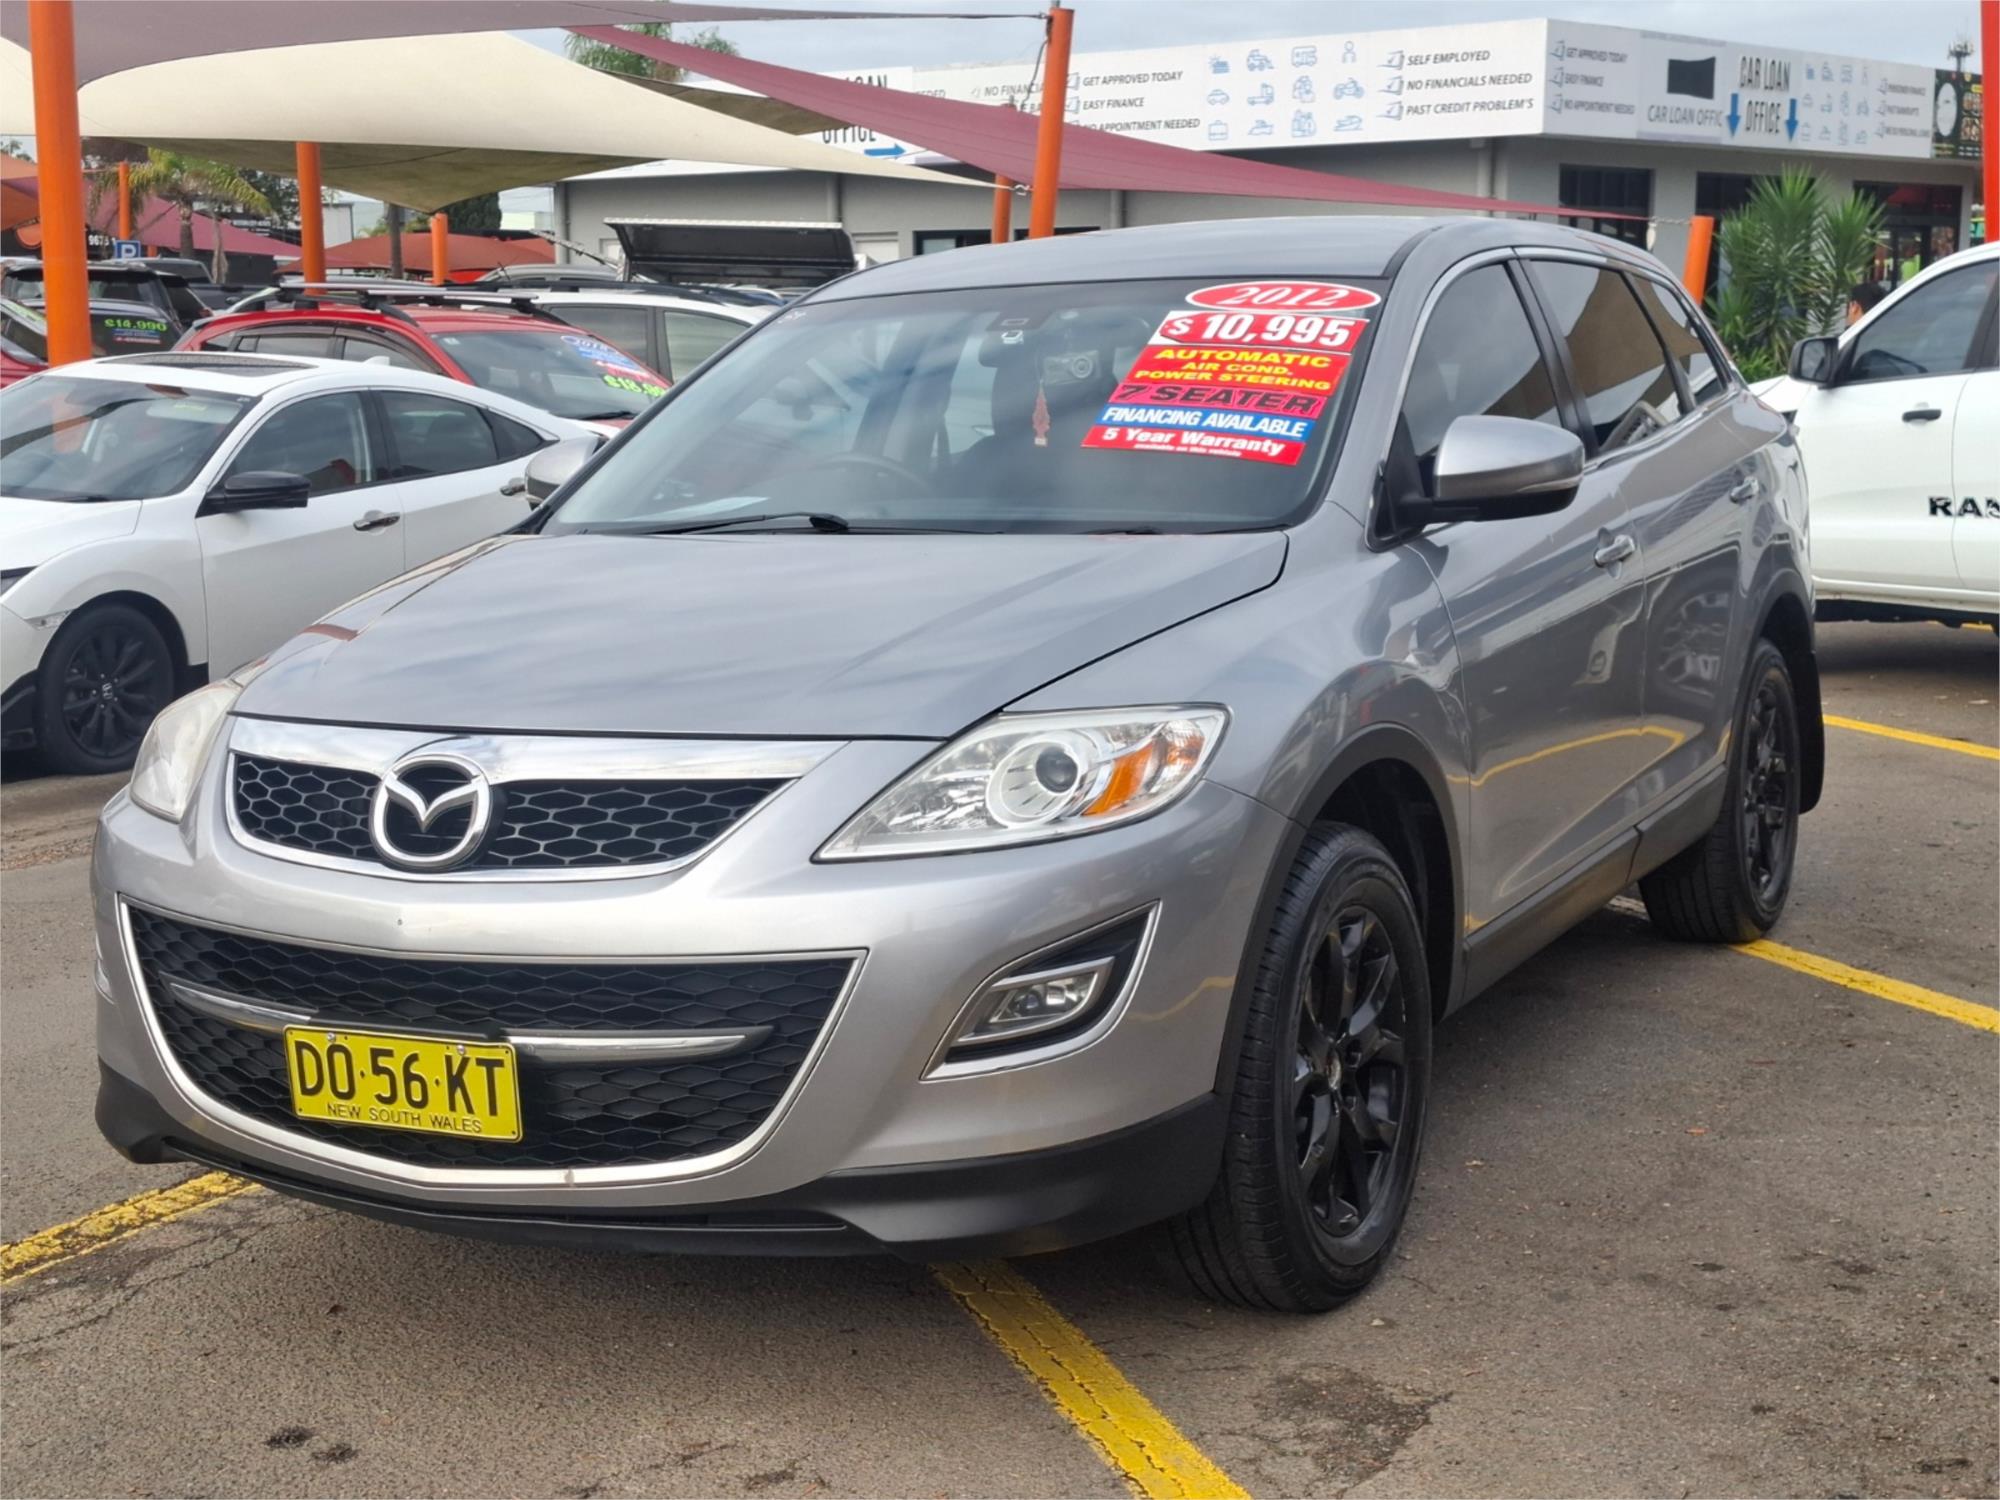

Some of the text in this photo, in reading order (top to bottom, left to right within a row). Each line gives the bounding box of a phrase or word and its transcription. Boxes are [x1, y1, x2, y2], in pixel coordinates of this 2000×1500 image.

[1408, 50, 1490, 66] SELF EMPLOYED
[1083, 71, 1183, 86] GET APPROVED TODAY
[1407, 73, 1532, 90] NO FINANCIALS NEEDED
[1739, 56, 1790, 92] CAR LOAN
[985, 86, 998, 96] NO
[1083, 97, 1144, 110] EASY FINANCE
[1406, 98, 1534, 115] PAST CREDIT PROBLEM'S
[1100, 120, 1163, 132] APPOINTMENT
[1164, 118, 1200, 129] NEEDED
[1648, 105, 1668, 122] CAR
[1668, 106, 1694, 125] LOAN
[1746, 100, 1780, 134] OFFICE
[121, 244, 137, 258] P
[1216, 287, 1351, 307] 2012
[1154, 348, 1332, 368] AUTOMATIC
[1181, 361, 1293, 376] AIR COND.
[1135, 370, 1332, 391] POWER STEERING
[1118, 383, 1320, 413] 7 SEATER
[1102, 406, 1308, 438] FINANCING AVAILABLE
[1102, 427, 1286, 457] 5 Year Warranty
[327, 1102, 482, 1133] NEW SOUTH WALES
